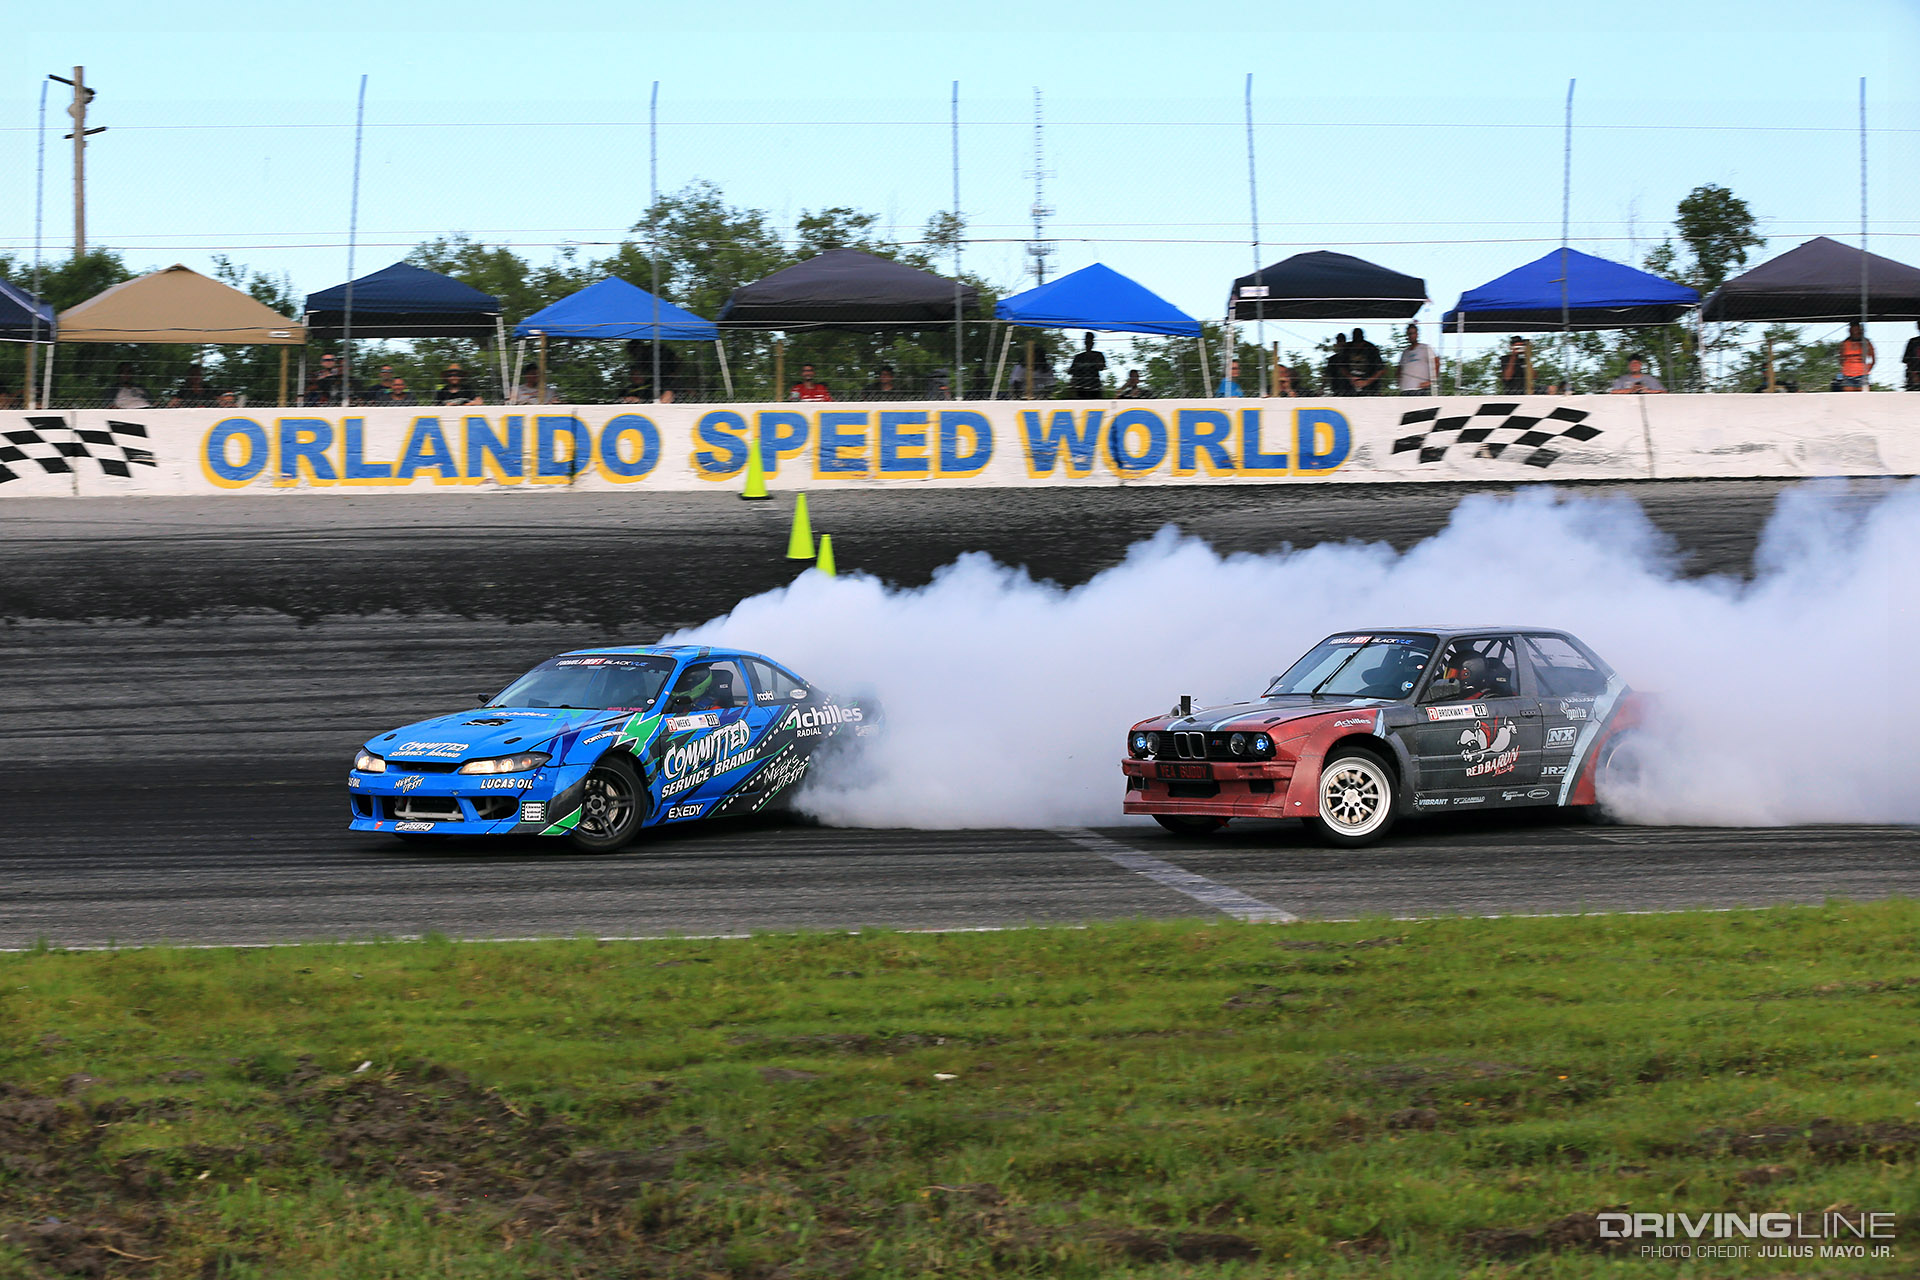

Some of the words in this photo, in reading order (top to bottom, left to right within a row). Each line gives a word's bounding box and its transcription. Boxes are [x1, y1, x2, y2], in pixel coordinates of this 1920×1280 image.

[200, 413, 663, 488] ORLANDO
[690, 408, 994, 482] SPEED
[1016, 407, 1352, 479] WORLD
[676, 718, 691, 729] MEEKS
[782, 705, 863, 731] Achilles
[1334, 718, 1371, 727] Achilles
[797, 727, 822, 738] RADIAL
[1549, 729, 1574, 742] NX
[664, 718, 751, 779] COMMITTED
[1466, 763, 1484, 777] RED
[1484, 745, 1520, 774] BARON
[662, 765, 710, 799] SERVICE
[714, 747, 755, 776] BRAND
[763, 755, 800, 784] MEEKS
[1160, 765, 1176, 778] YEA
[1180, 765, 1207, 778] BUDDY
[1541, 766, 1567, 775] JRZ
[480, 778, 515, 790] LUCAS
[517, 778, 534, 790] OIL
[1419, 798, 1449, 806] VIBRANT
[668, 803, 703, 819] EXEDY
